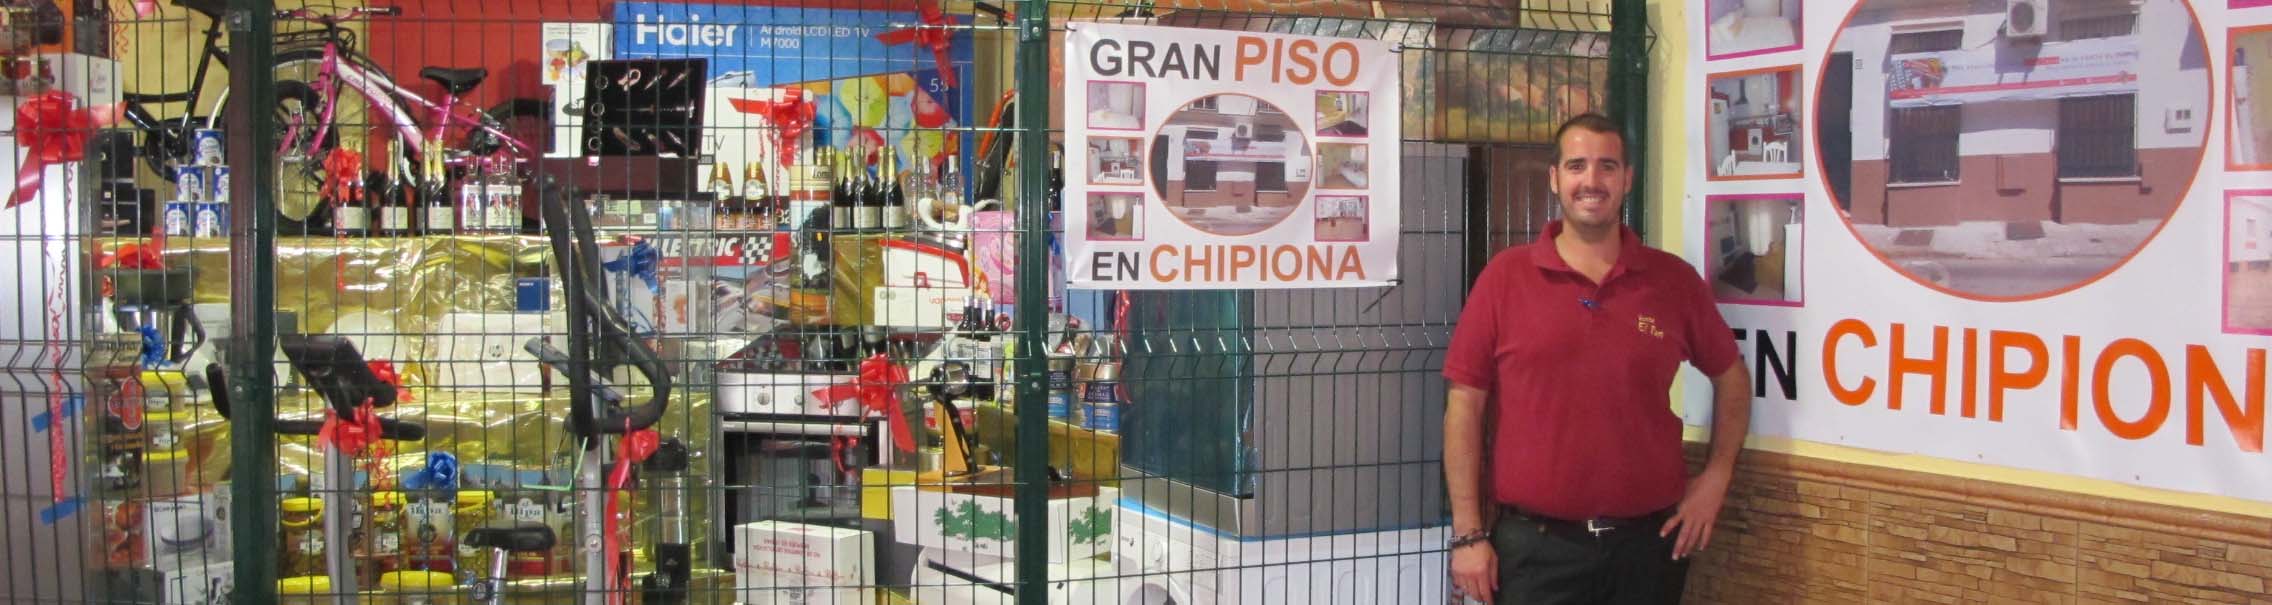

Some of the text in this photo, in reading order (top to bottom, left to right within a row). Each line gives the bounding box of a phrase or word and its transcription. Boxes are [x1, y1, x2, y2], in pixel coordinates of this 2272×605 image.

[637, 13, 737, 47] Haier
[1090, 36, 1360, 87] GRAN PISO
[1091, 244, 1366, 282] EN CHIPIONA
[1822, 318, 2267, 453] CHIPION
